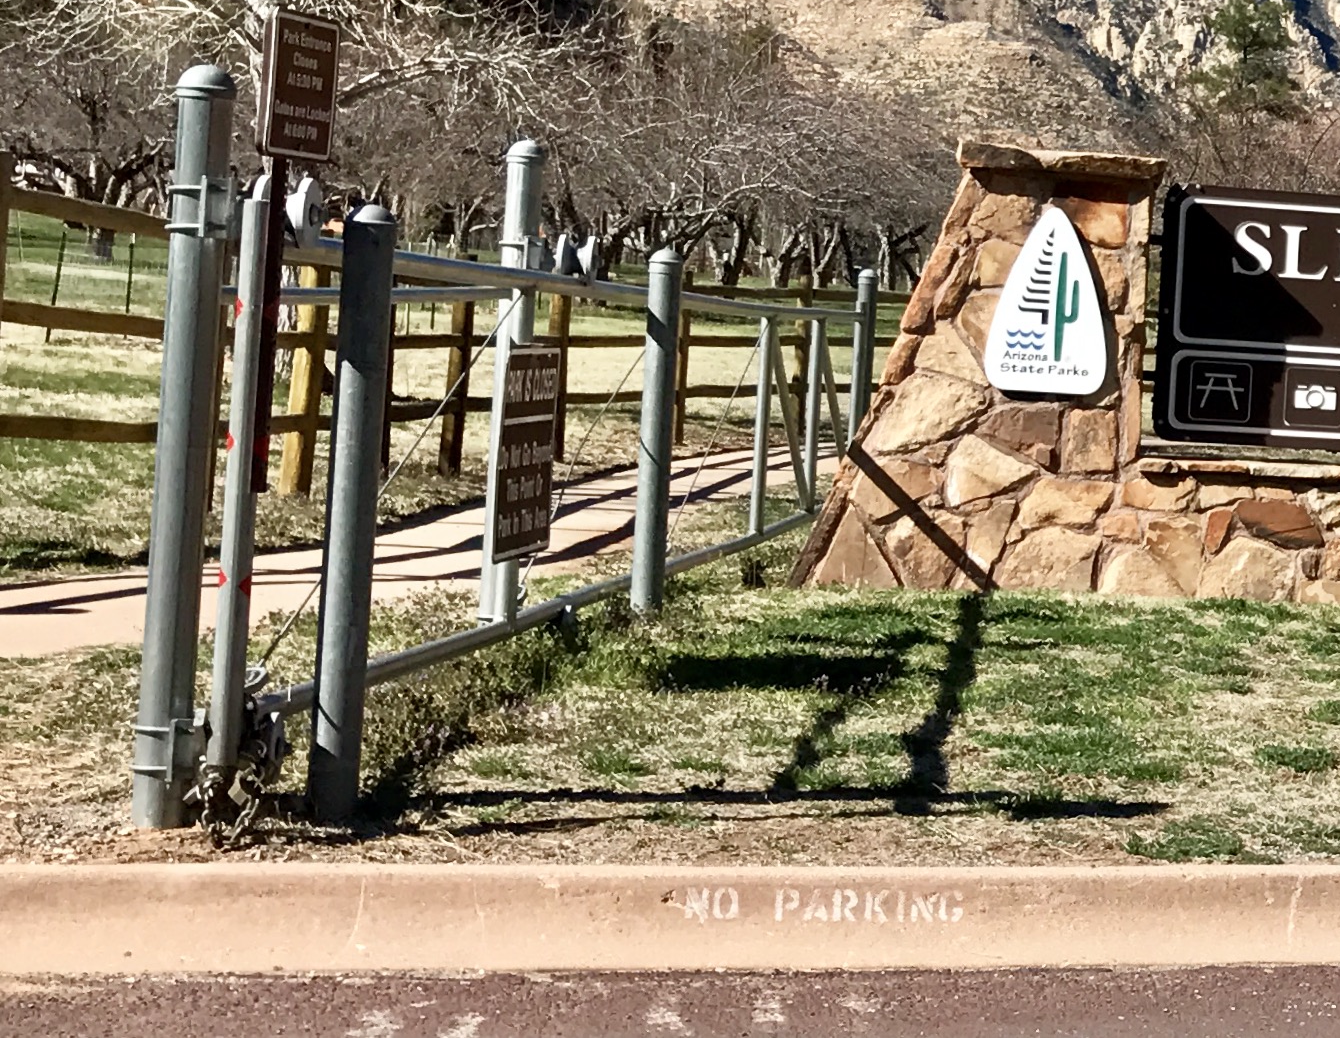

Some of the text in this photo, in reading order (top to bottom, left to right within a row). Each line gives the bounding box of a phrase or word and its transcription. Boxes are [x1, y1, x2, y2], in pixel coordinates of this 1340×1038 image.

[283, 28, 332, 53] Park Entrance
[293, 51, 318, 70] Closes
[312, 76, 324, 91] PM
[306, 126, 317, 141] PM
[1002, 350, 1048, 362] Arizona
[1000, 362, 1089, 377] State Parks
[684, 887, 964, 923] NO PARKING
